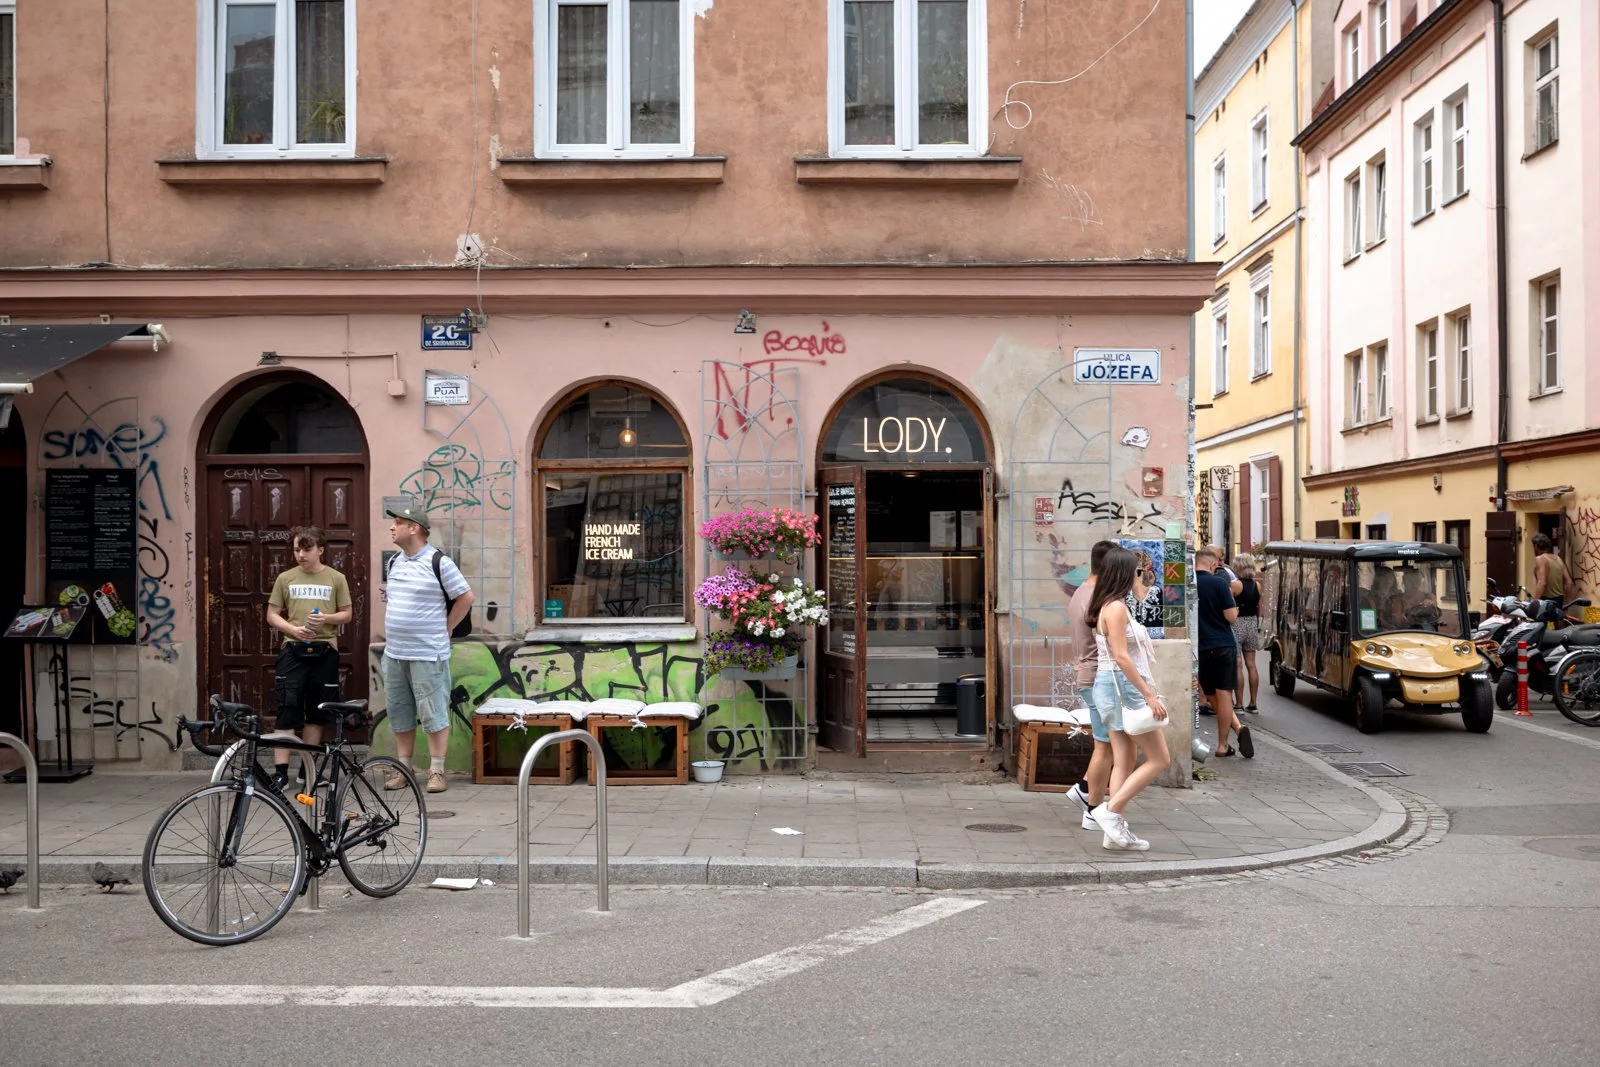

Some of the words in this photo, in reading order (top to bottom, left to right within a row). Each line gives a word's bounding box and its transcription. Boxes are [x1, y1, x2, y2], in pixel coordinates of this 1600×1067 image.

[1104, 354, 1132, 362] ULICA
[1082, 362, 1154, 380] JÓZEFA
[434, 386, 461, 396] PUAT
[863, 416, 952, 454] LODY.
[1213, 467, 1232, 476] VOL
[585, 524, 612, 535] HAND
[613, 524, 641, 535] MADE
[585, 536, 621, 548] FRENCH
[585, 548, 600, 560] ICE
[600, 548, 633, 560] CREAM
